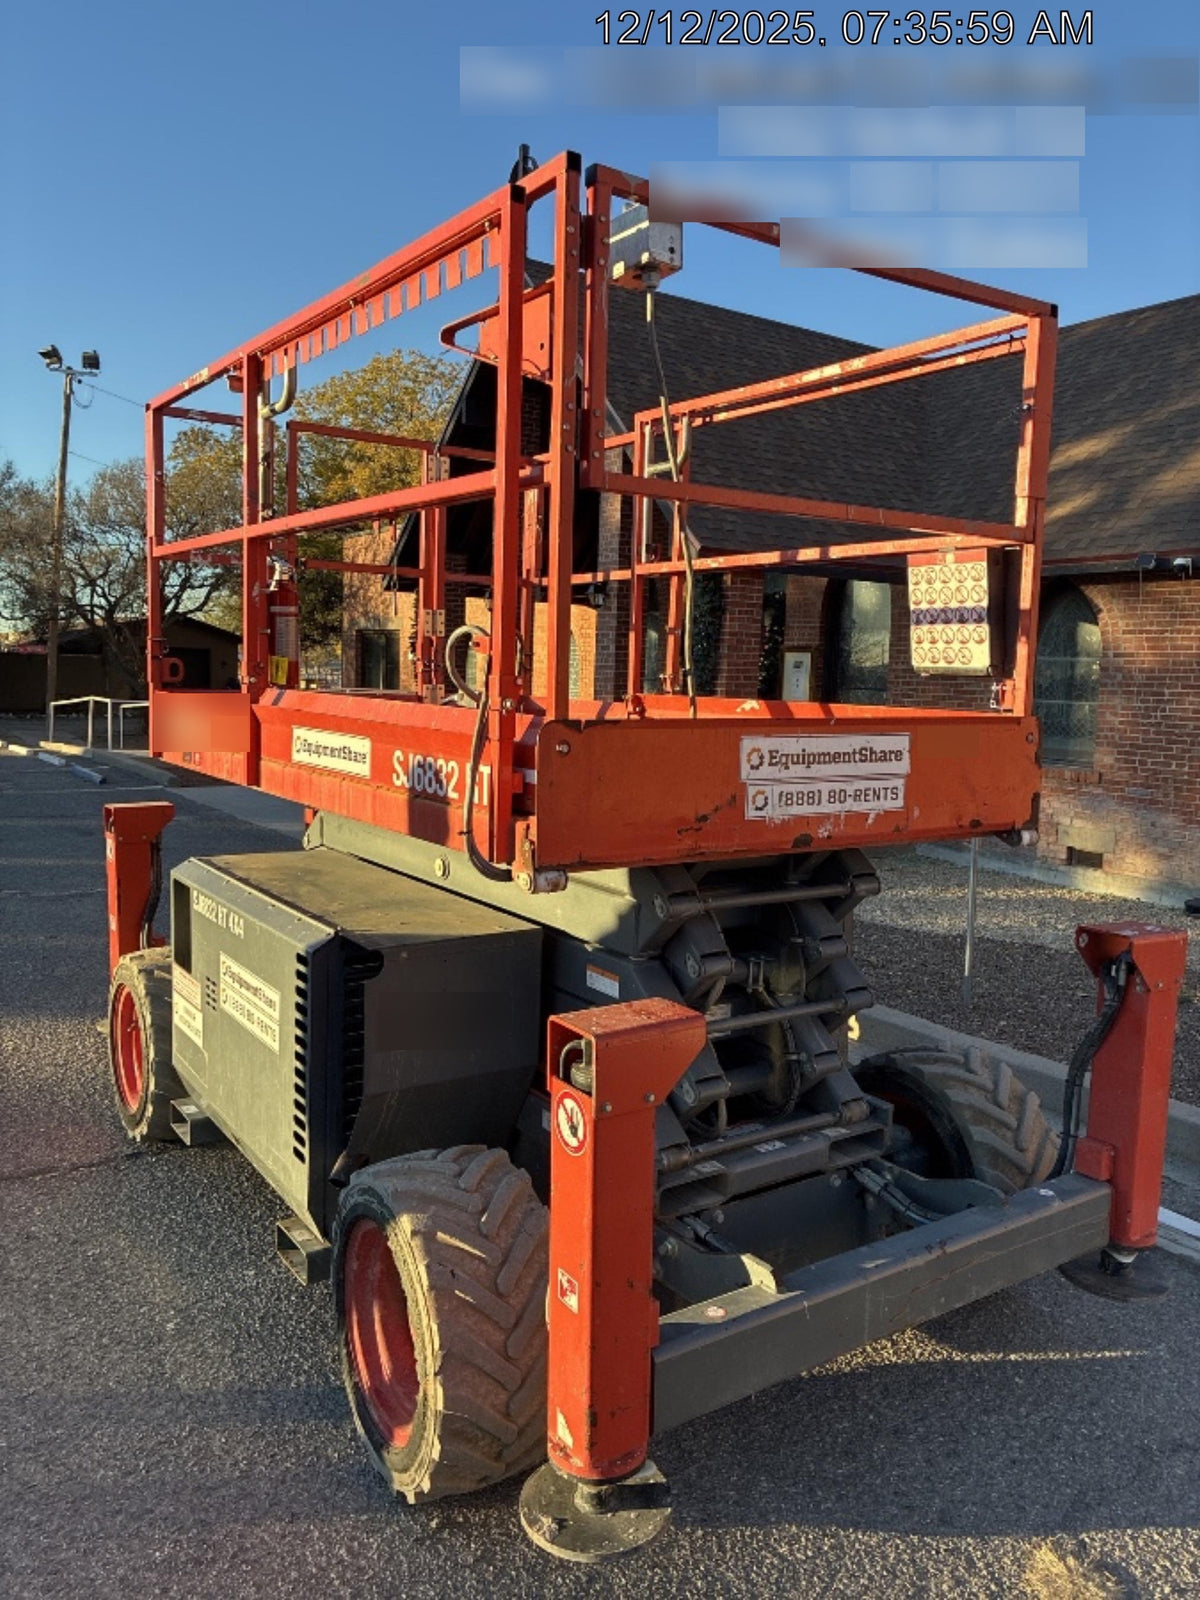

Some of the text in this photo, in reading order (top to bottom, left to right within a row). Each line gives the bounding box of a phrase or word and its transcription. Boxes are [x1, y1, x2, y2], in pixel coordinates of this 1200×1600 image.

[767, 746, 904, 770] EquipmentShare
[392, 749, 460, 800] SJ6832
[778, 786, 899, 808] (888) 80-RENTS
